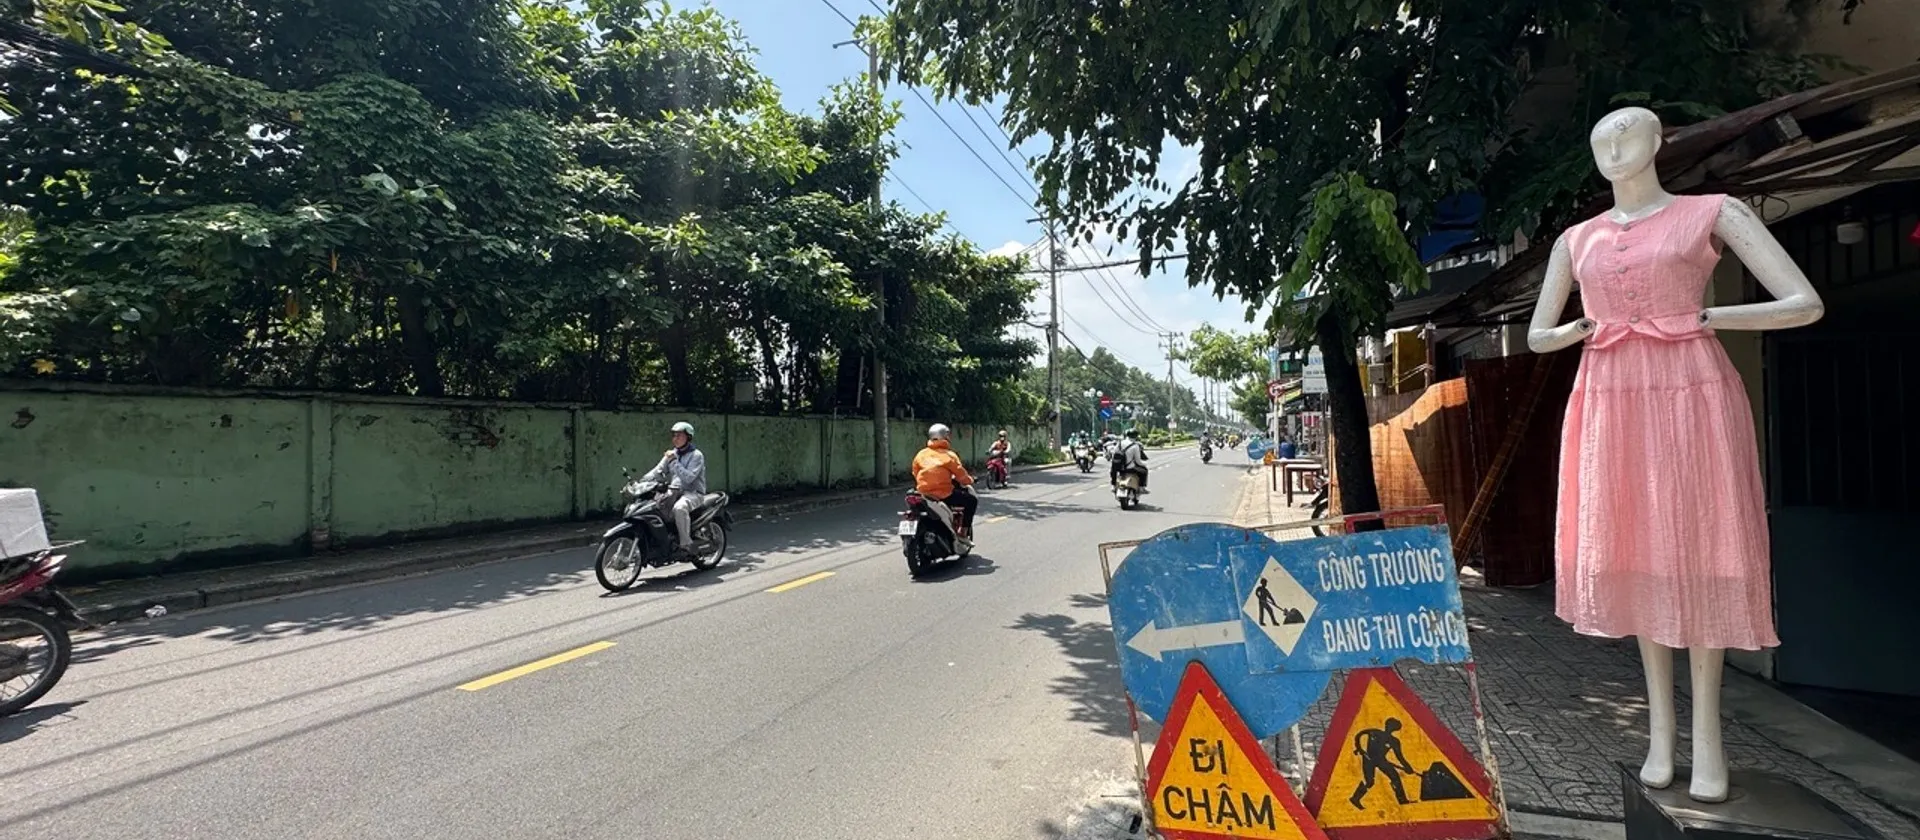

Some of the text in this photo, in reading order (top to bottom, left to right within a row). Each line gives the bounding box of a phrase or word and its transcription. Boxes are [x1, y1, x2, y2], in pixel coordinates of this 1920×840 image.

[1318, 542, 1445, 592] CÔNG TRƯỜNG
[1322, 618, 1371, 653] ĐANG
[1373, 614, 1405, 649] THI
[1190, 738, 1227, 775] ĐI
[1163, 782, 1276, 831] CHẬM
